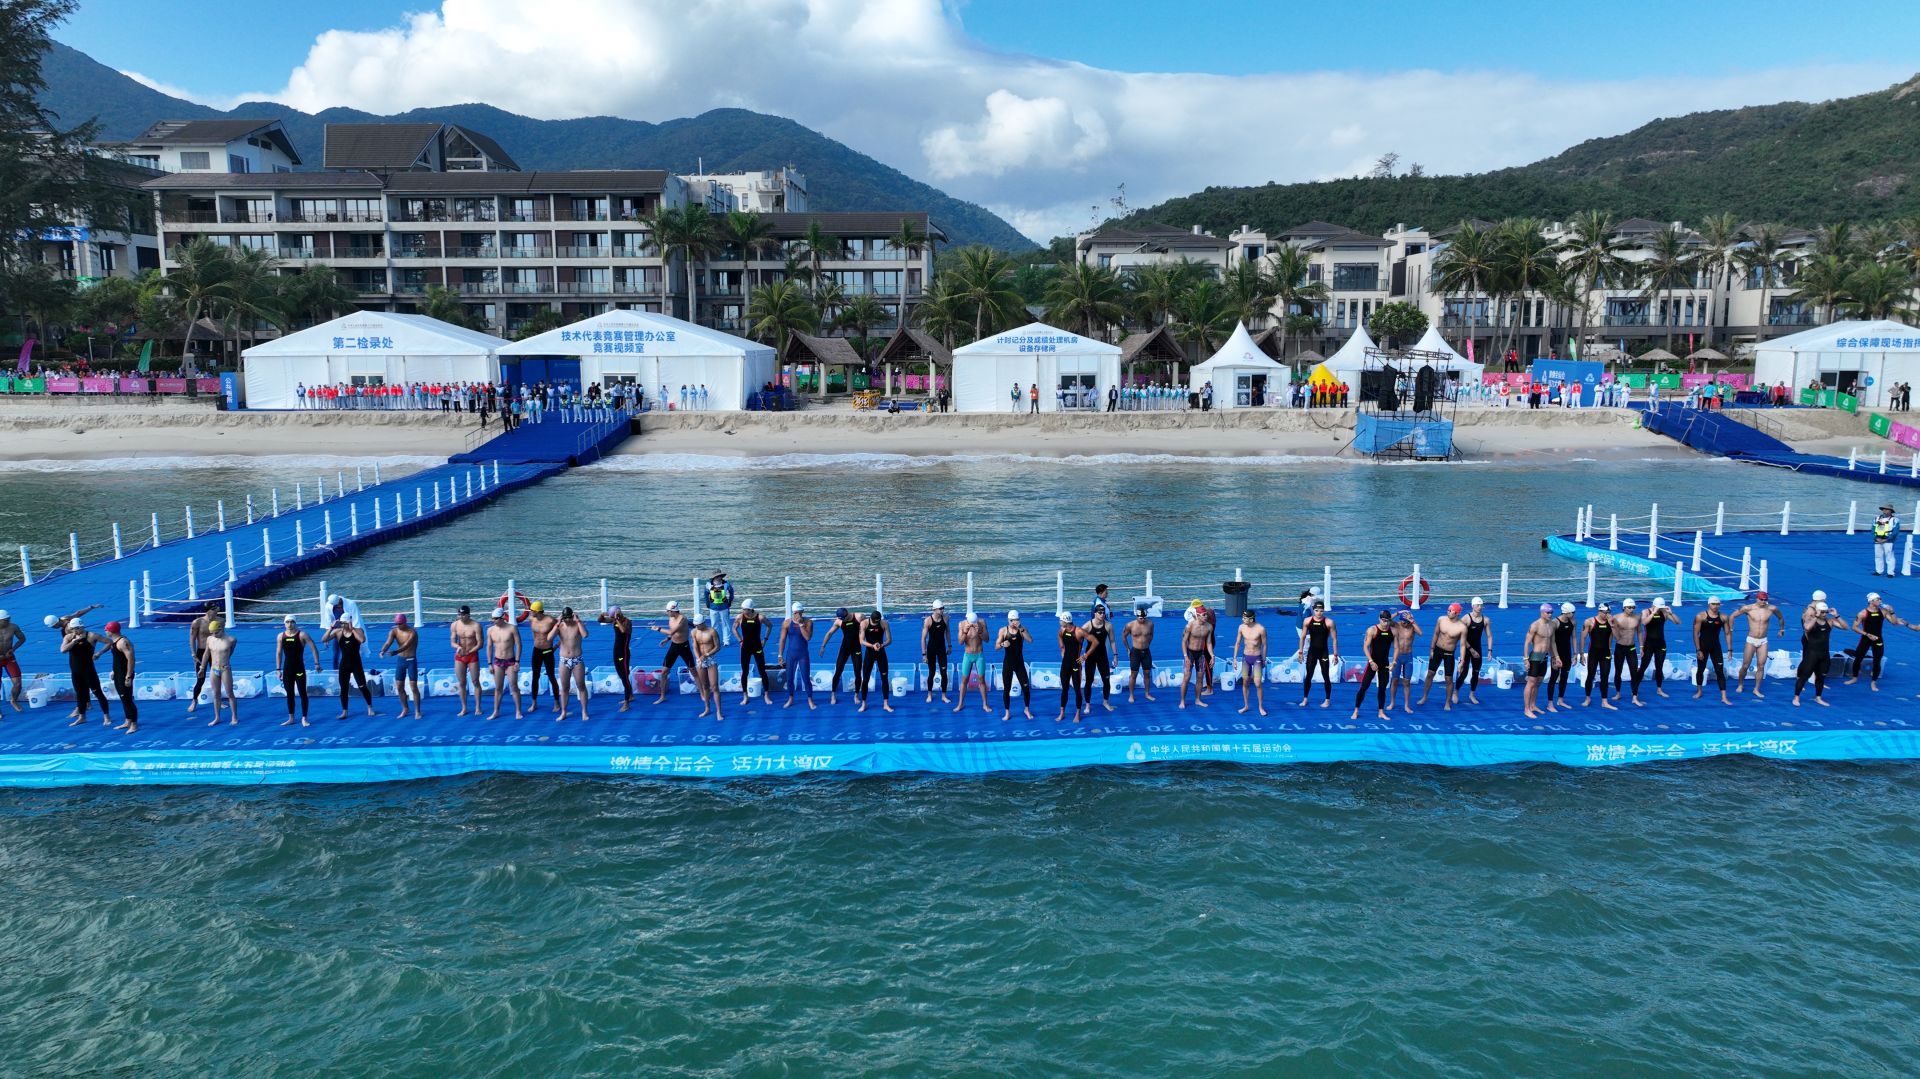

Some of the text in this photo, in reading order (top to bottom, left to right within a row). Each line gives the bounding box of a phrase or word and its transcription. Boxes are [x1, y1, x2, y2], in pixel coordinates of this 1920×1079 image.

[561, 330, 676, 342] 技术代表竞赛管理办公室
[332, 336, 394, 349] 第二检录处
[593, 342, 645, 353] 竞赛视频室
[1104, 726, 1131, 734] 21
[1146, 724, 1176, 732] 20
[1190, 724, 1219, 732] 19
[1232, 723, 1262, 731] 18
[1278, 723, 1306, 731] 17
[1363, 722, 1394, 730] 15
[1409, 723, 1440, 731] 14
[1453, 723, 1486, 731] 13
[741, 733, 770, 742] 29
[788, 733, 817, 742] 28
[832, 731, 862, 741] 27
[875, 731, 907, 740] 26
[922, 731, 953, 739] 25
[965, 730, 997, 739] 24
[1011, 729, 1041, 738] 23
[223, 738, 262, 746] 40
[363, 736, 396, 744] 37
[411, 735, 447, 744] 36
[556, 734, 586, 743] 33
[599, 734, 631, 743] 32
[650, 734, 676, 743] 31
[692, 734, 721, 743] 30
[1150, 743, 1292, 755] 中华人民共和国第十五届运动会
[1586, 743, 1686, 761] 激情全运会
[610, 755, 833, 772] 激情全运会 活力大湾区
